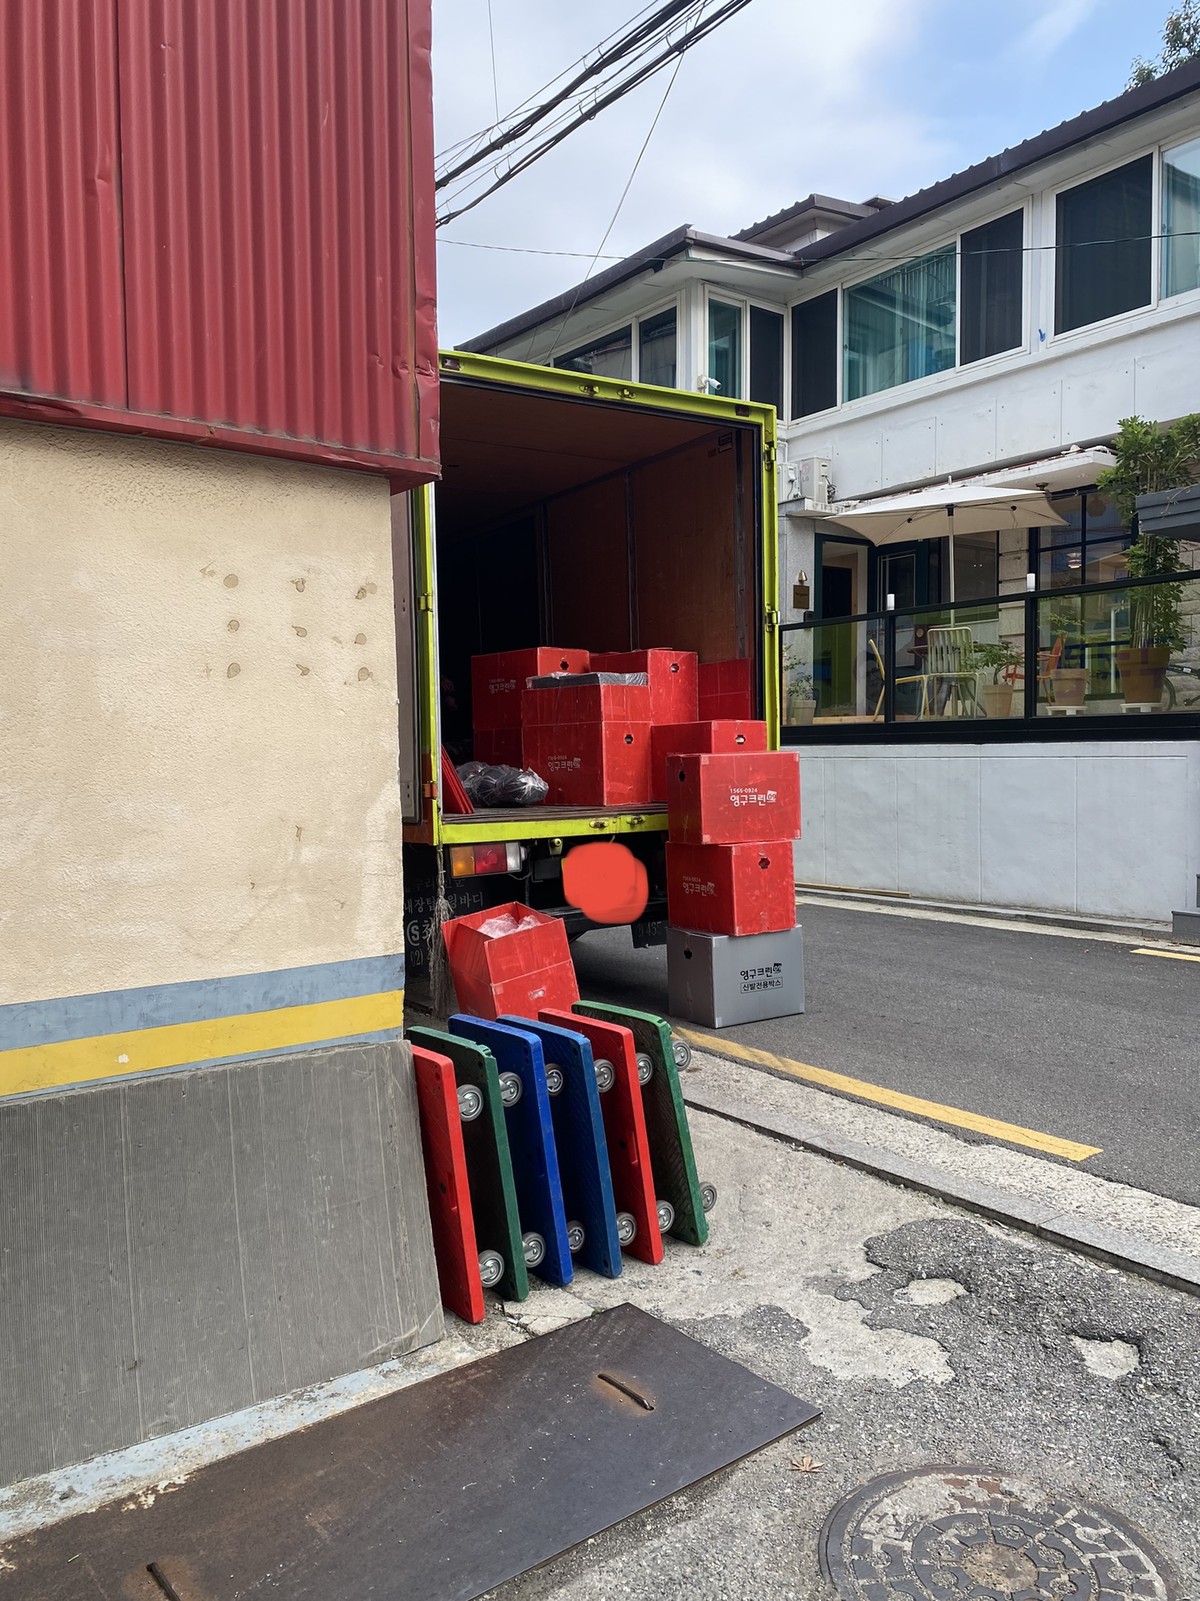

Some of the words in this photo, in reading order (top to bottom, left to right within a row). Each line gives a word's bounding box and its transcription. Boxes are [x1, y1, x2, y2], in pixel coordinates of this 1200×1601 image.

[547, 761, 573, 772] 영구크린
[729, 794, 766, 807] 영구크린
[682, 882, 707, 897] 영구크린
[740, 967, 773, 981] 영구크린
[742, 980, 782, 991] 신발전용박스
